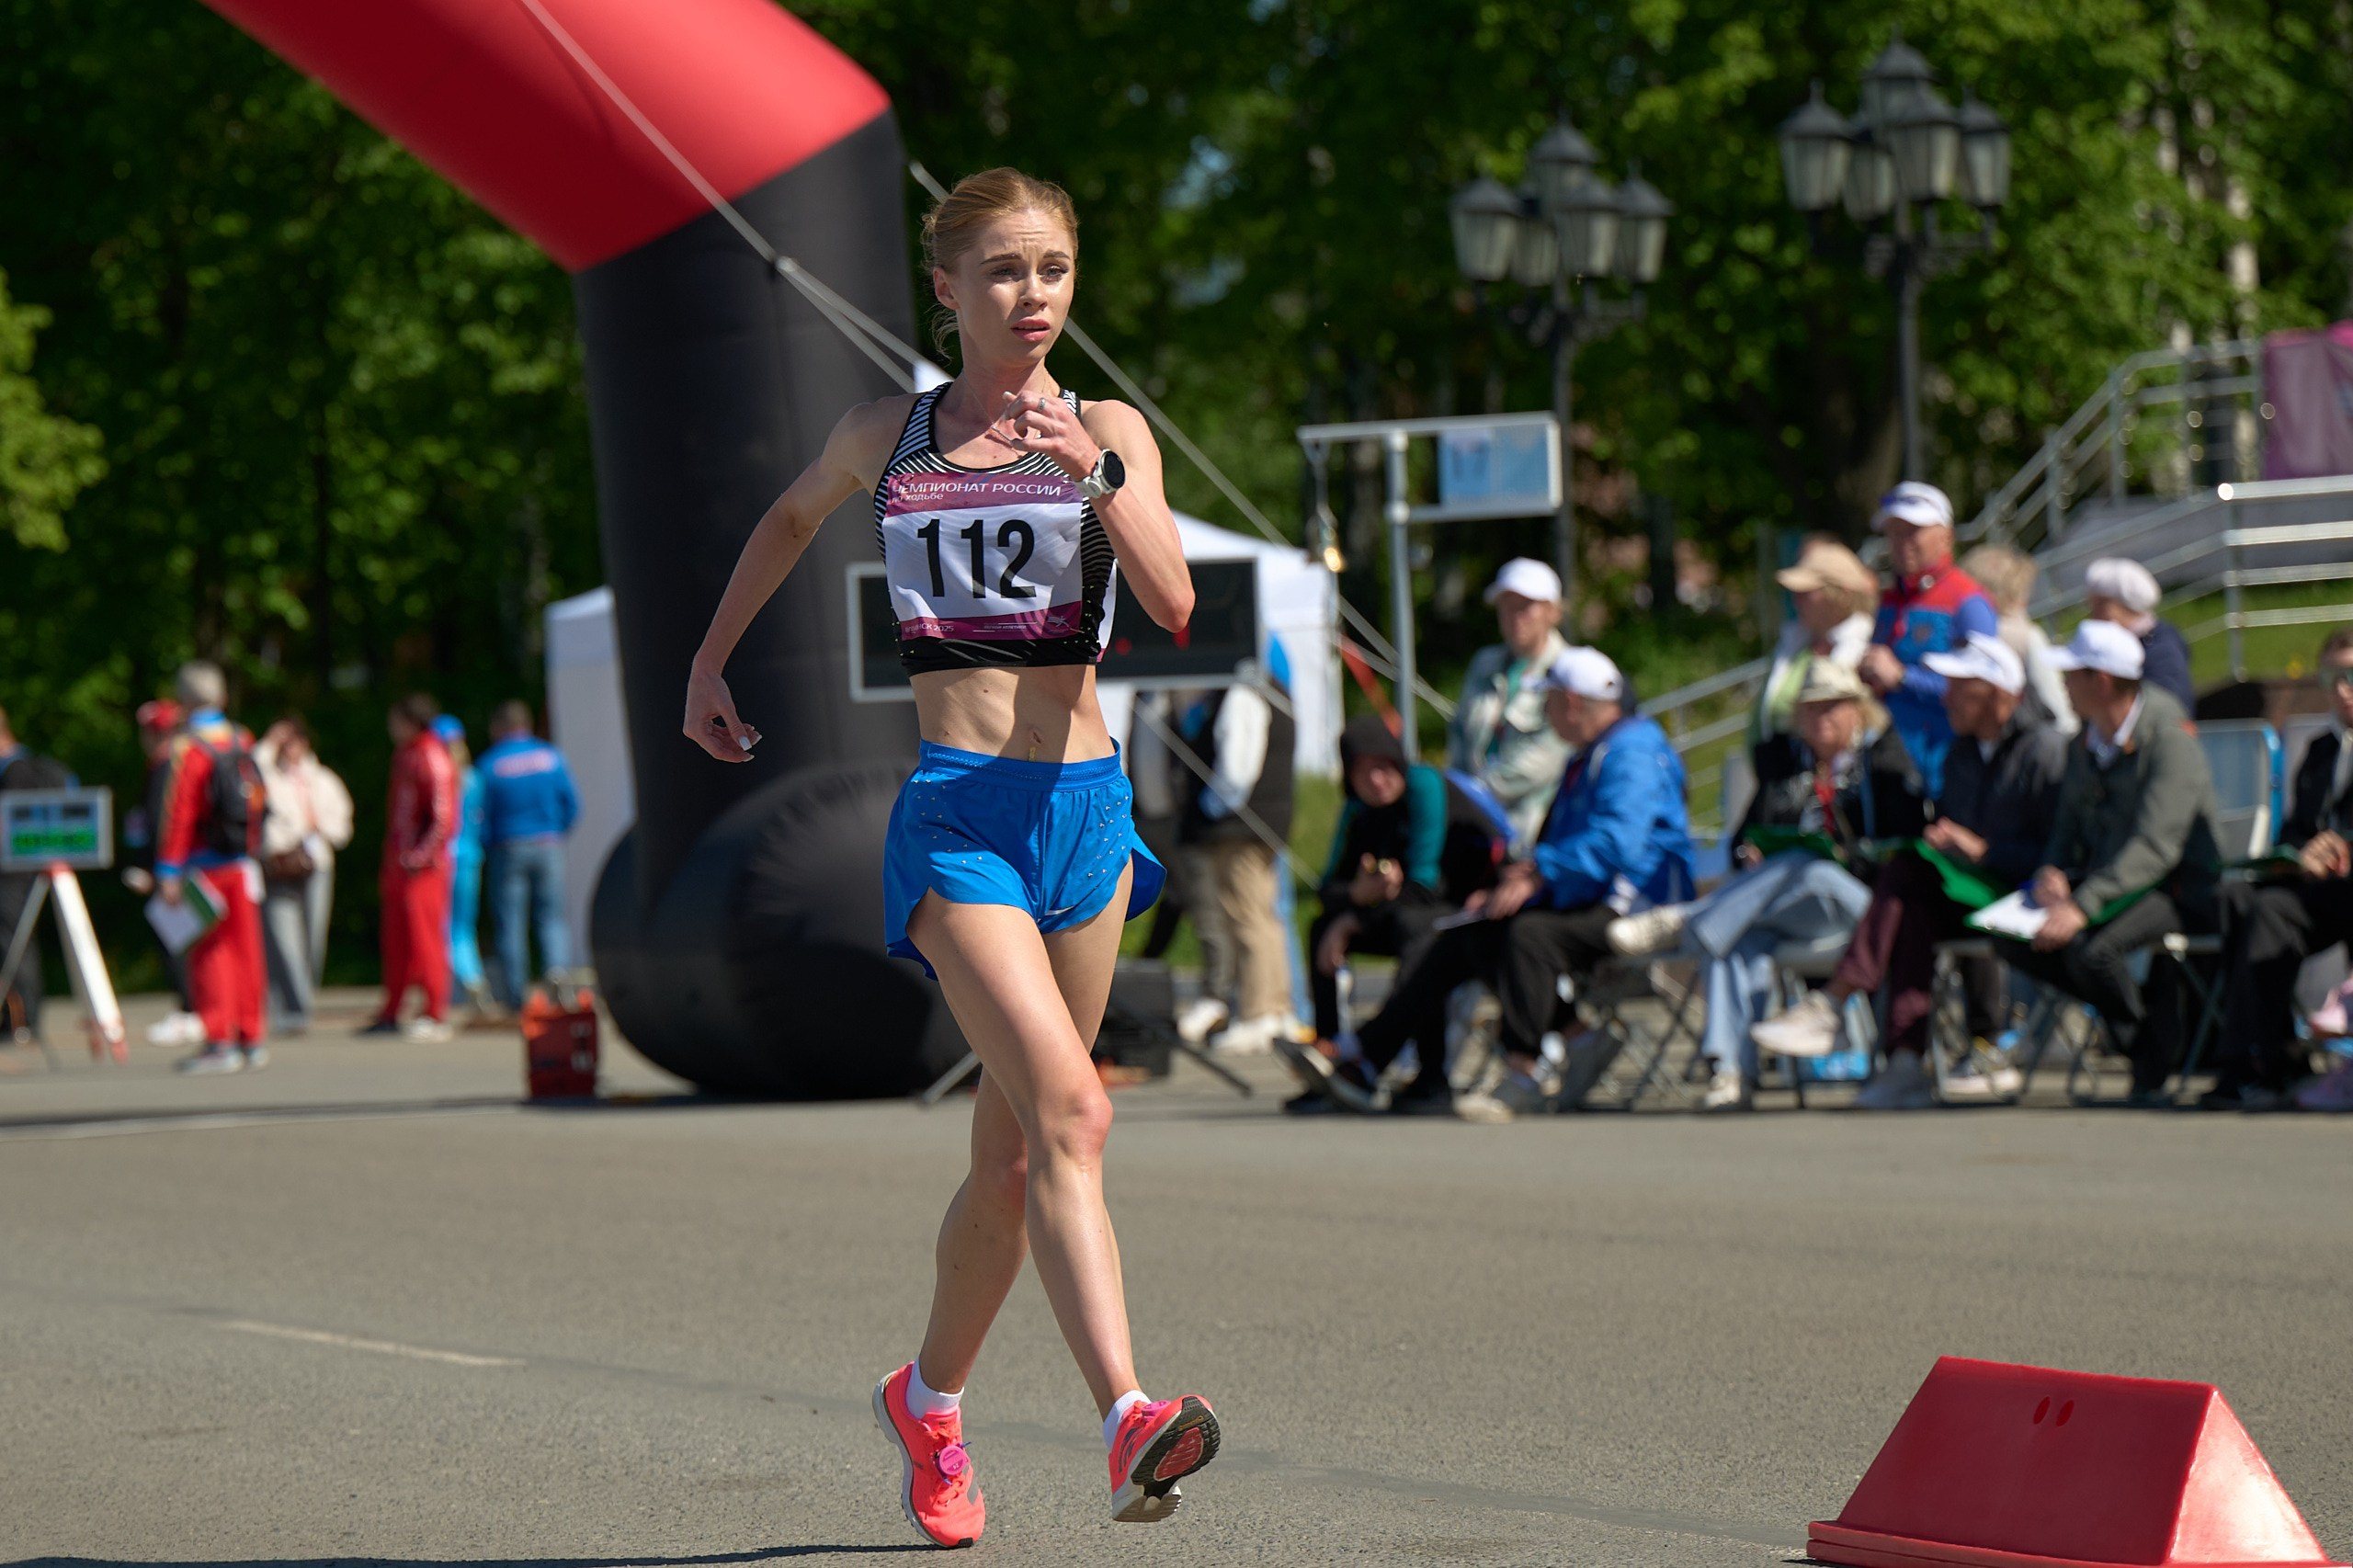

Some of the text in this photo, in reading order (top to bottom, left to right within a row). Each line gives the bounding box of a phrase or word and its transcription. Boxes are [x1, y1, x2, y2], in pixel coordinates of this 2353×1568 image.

[892, 483, 1062, 496] ЧЕМПИОНАТ РОССИИ
[905, 493, 944, 502] ходьбе
[917, 518, 1037, 599] 112
[933, 624, 954, 632] 2025
